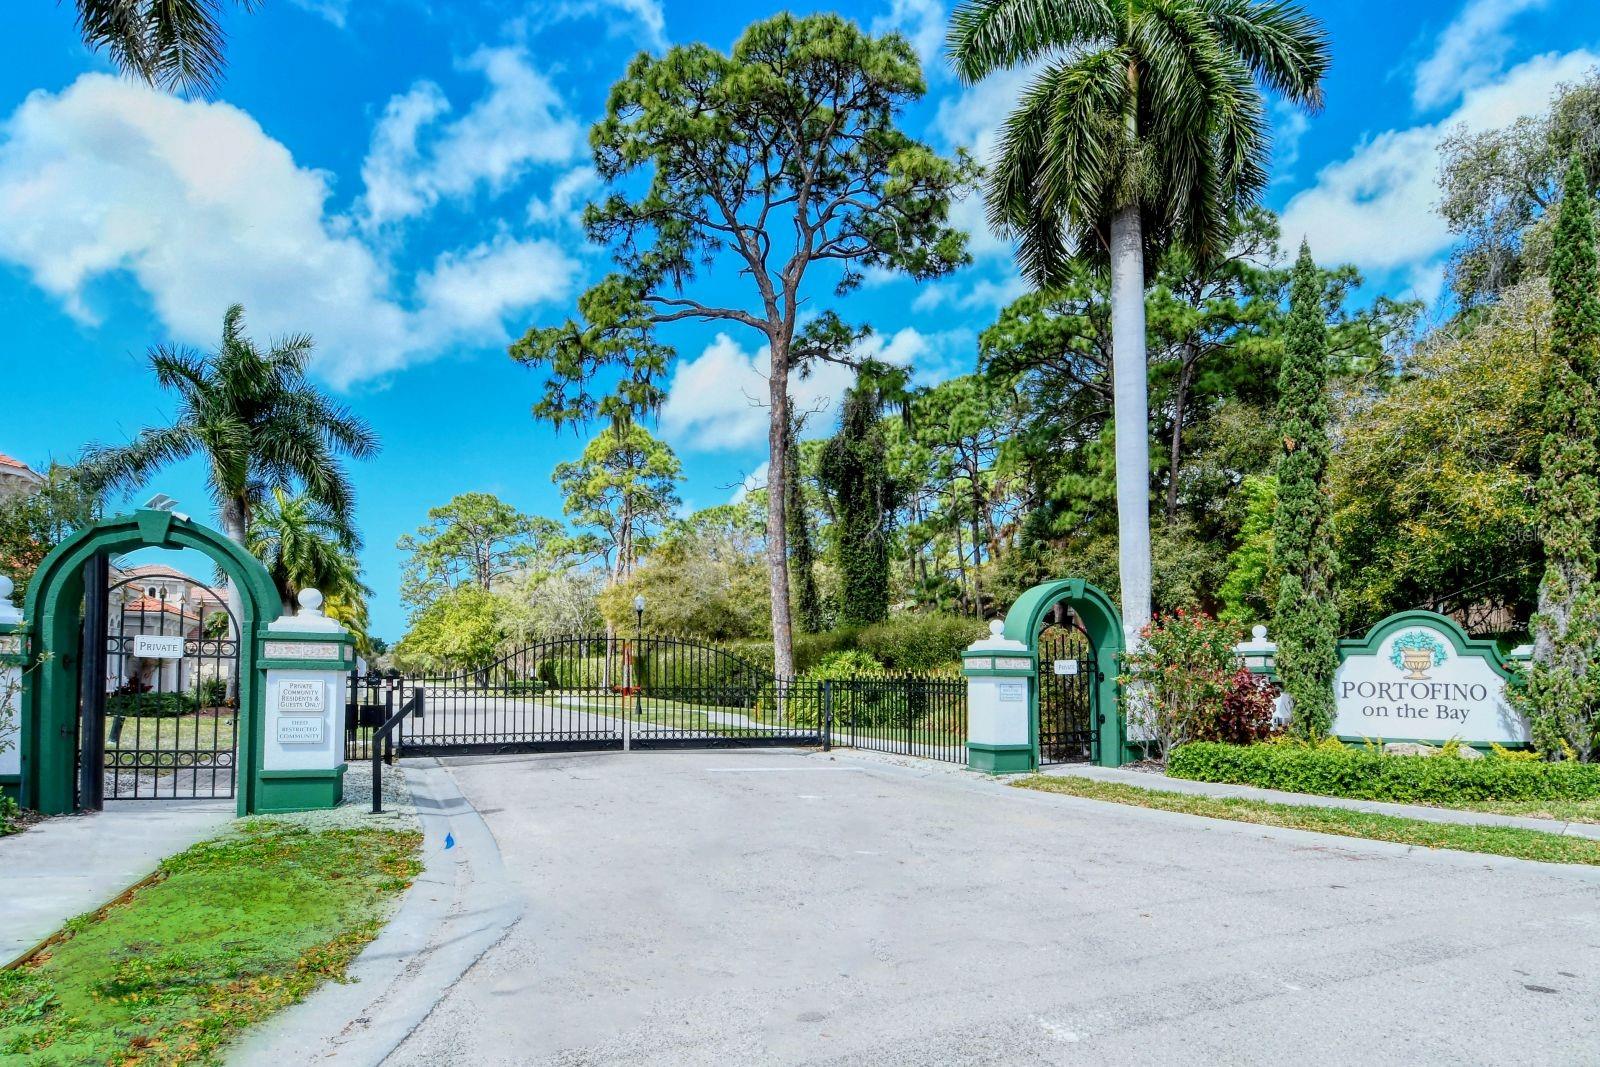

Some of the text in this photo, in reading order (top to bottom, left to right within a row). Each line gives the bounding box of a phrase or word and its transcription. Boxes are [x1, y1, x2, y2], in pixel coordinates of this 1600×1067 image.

[140, 641, 178, 652] PRIVATE
[1341, 681, 1487, 702] PORTOFINO
[1362, 703, 1471, 724] on the Bay
